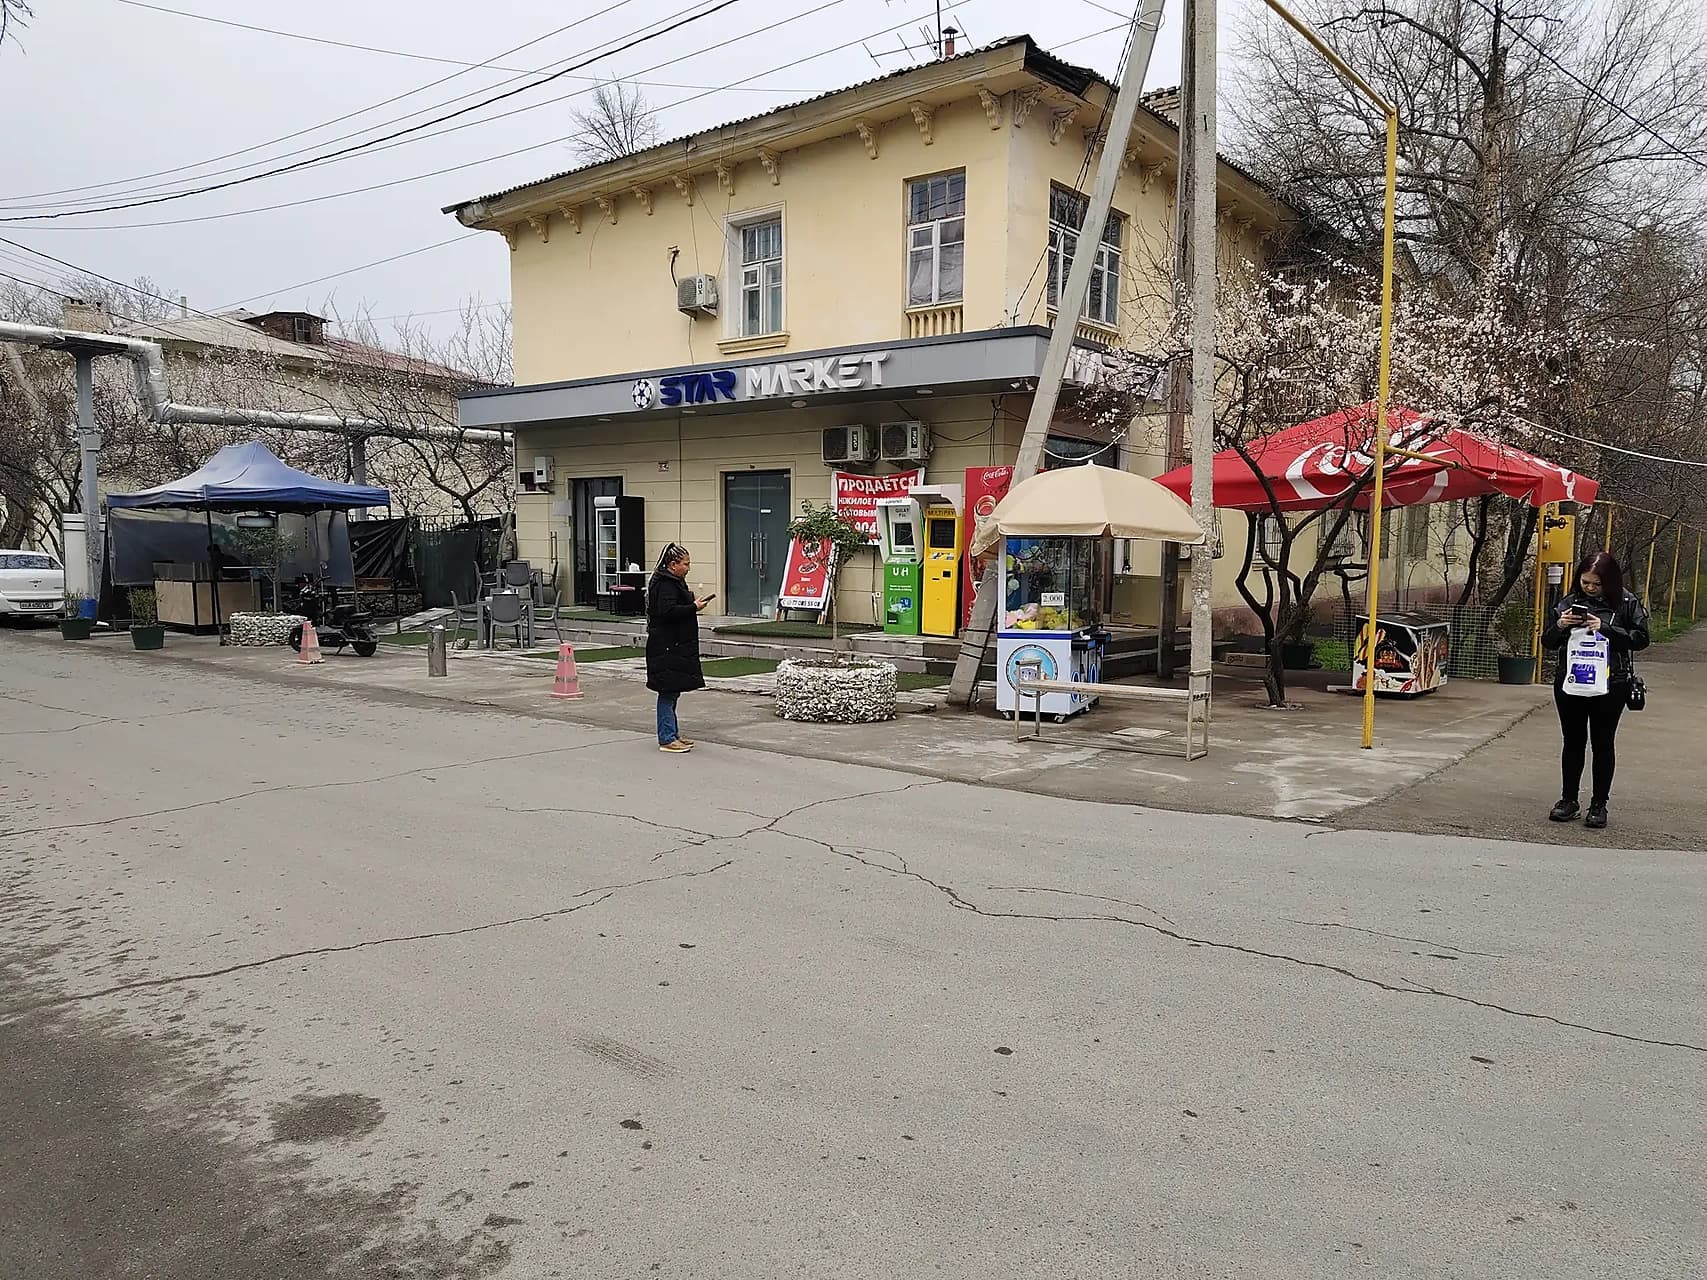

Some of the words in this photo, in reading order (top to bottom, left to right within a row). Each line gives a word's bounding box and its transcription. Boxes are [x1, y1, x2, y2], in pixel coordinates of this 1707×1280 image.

[660, 370, 737, 406] STAR
[746, 351, 891, 398] MARKET
[838, 475, 916, 495] ПРОДАЁТСЯ
